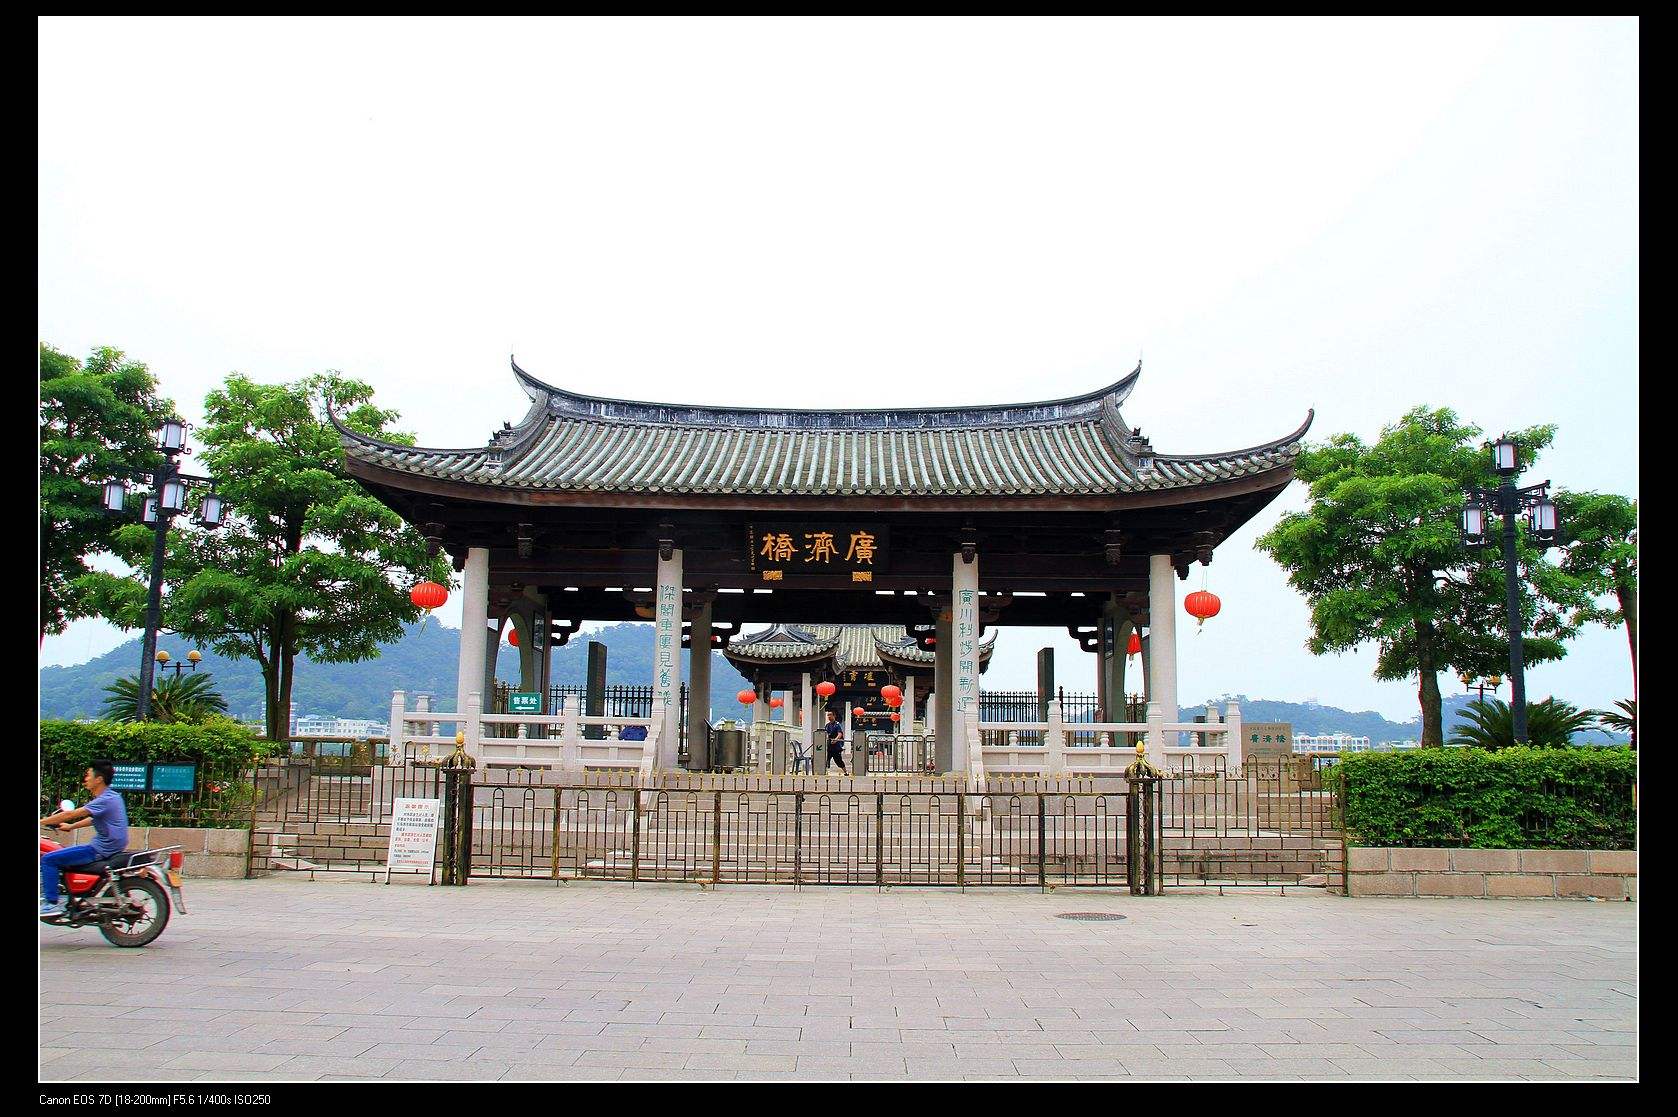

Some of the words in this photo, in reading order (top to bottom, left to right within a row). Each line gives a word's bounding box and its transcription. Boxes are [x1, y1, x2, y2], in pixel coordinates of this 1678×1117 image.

[760, 530, 878, 564] 廣濟橋
[513, 696, 538, 705] 售票处
